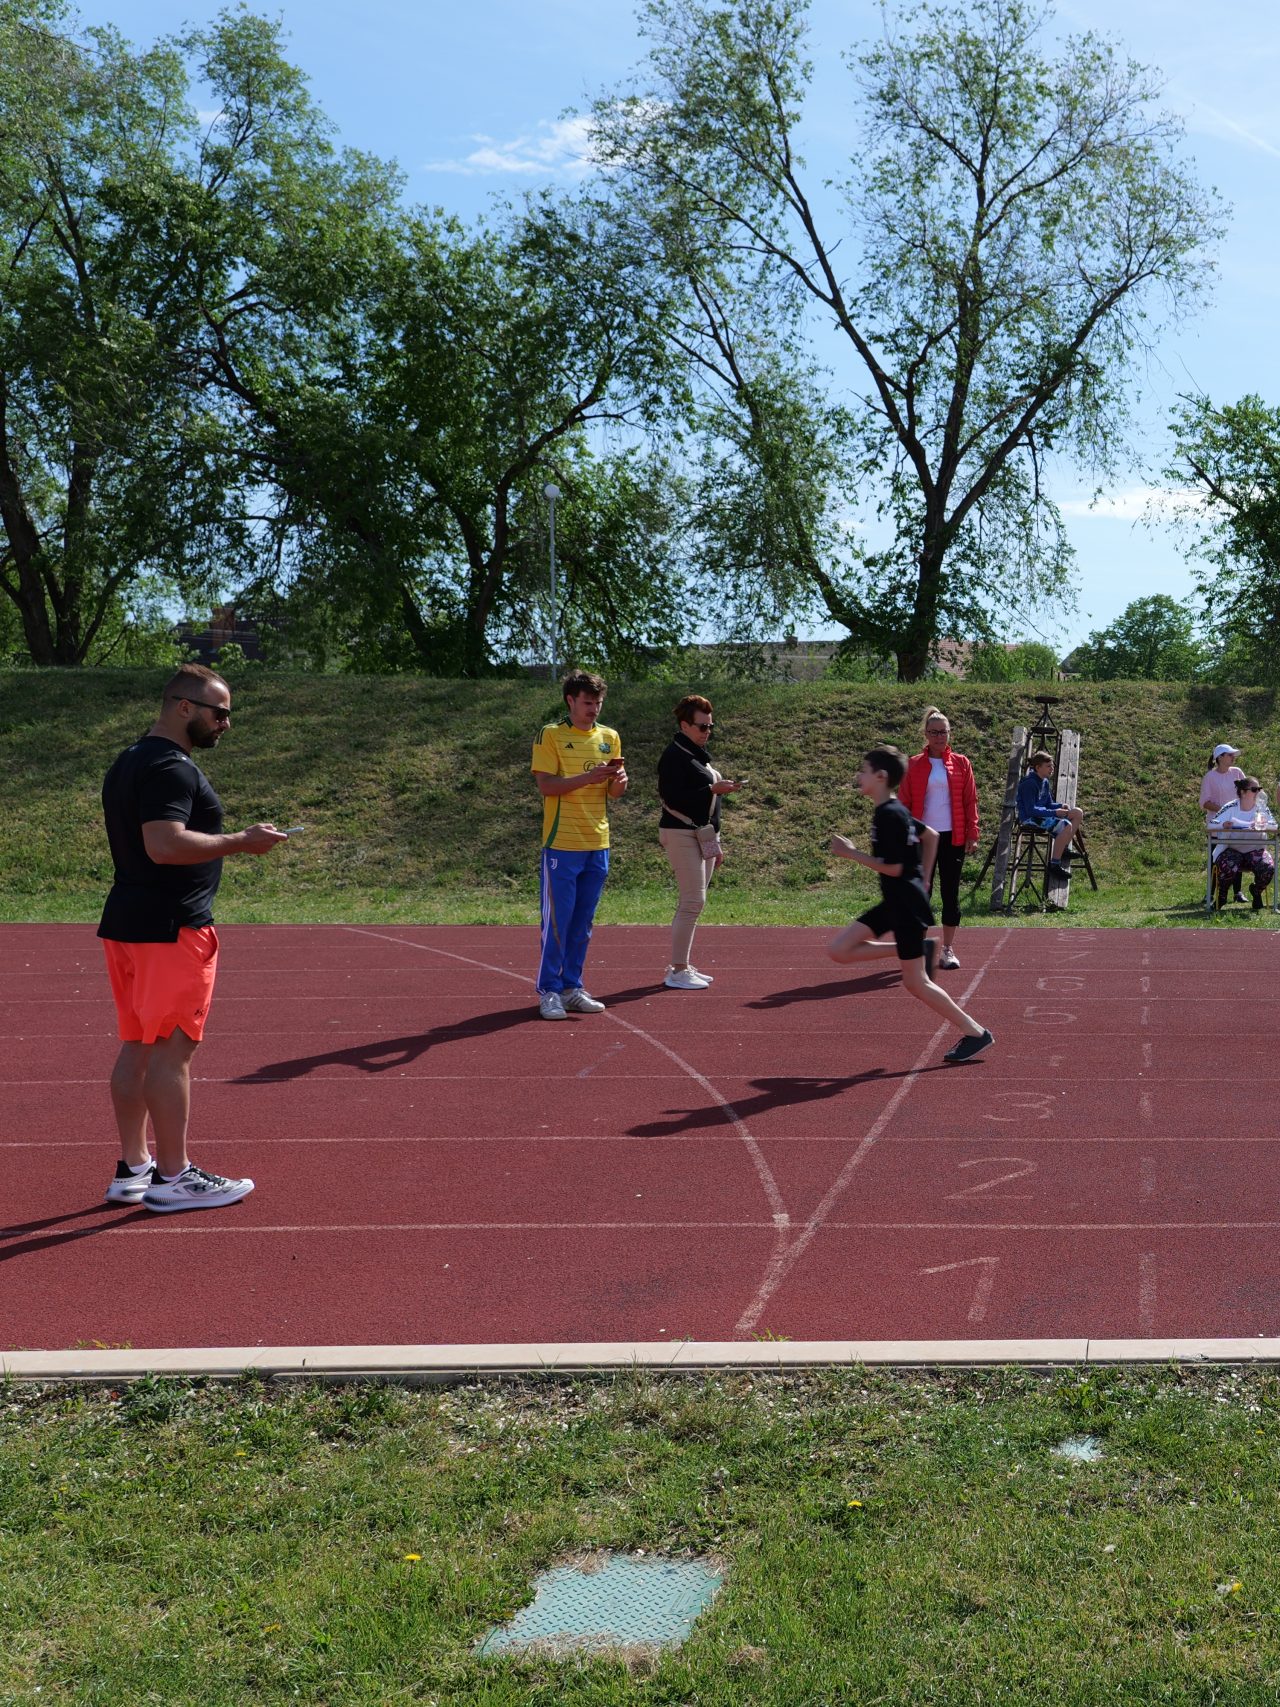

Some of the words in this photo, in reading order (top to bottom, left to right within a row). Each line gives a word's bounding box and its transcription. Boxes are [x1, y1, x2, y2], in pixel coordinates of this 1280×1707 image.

[1035, 975, 1087, 992] 6
[1022, 1005, 1079, 1025] 5
[981, 1090, 1057, 1122] 3
[943, 1156, 1038, 1201] 2
[915, 1255, 1001, 1322] 1
